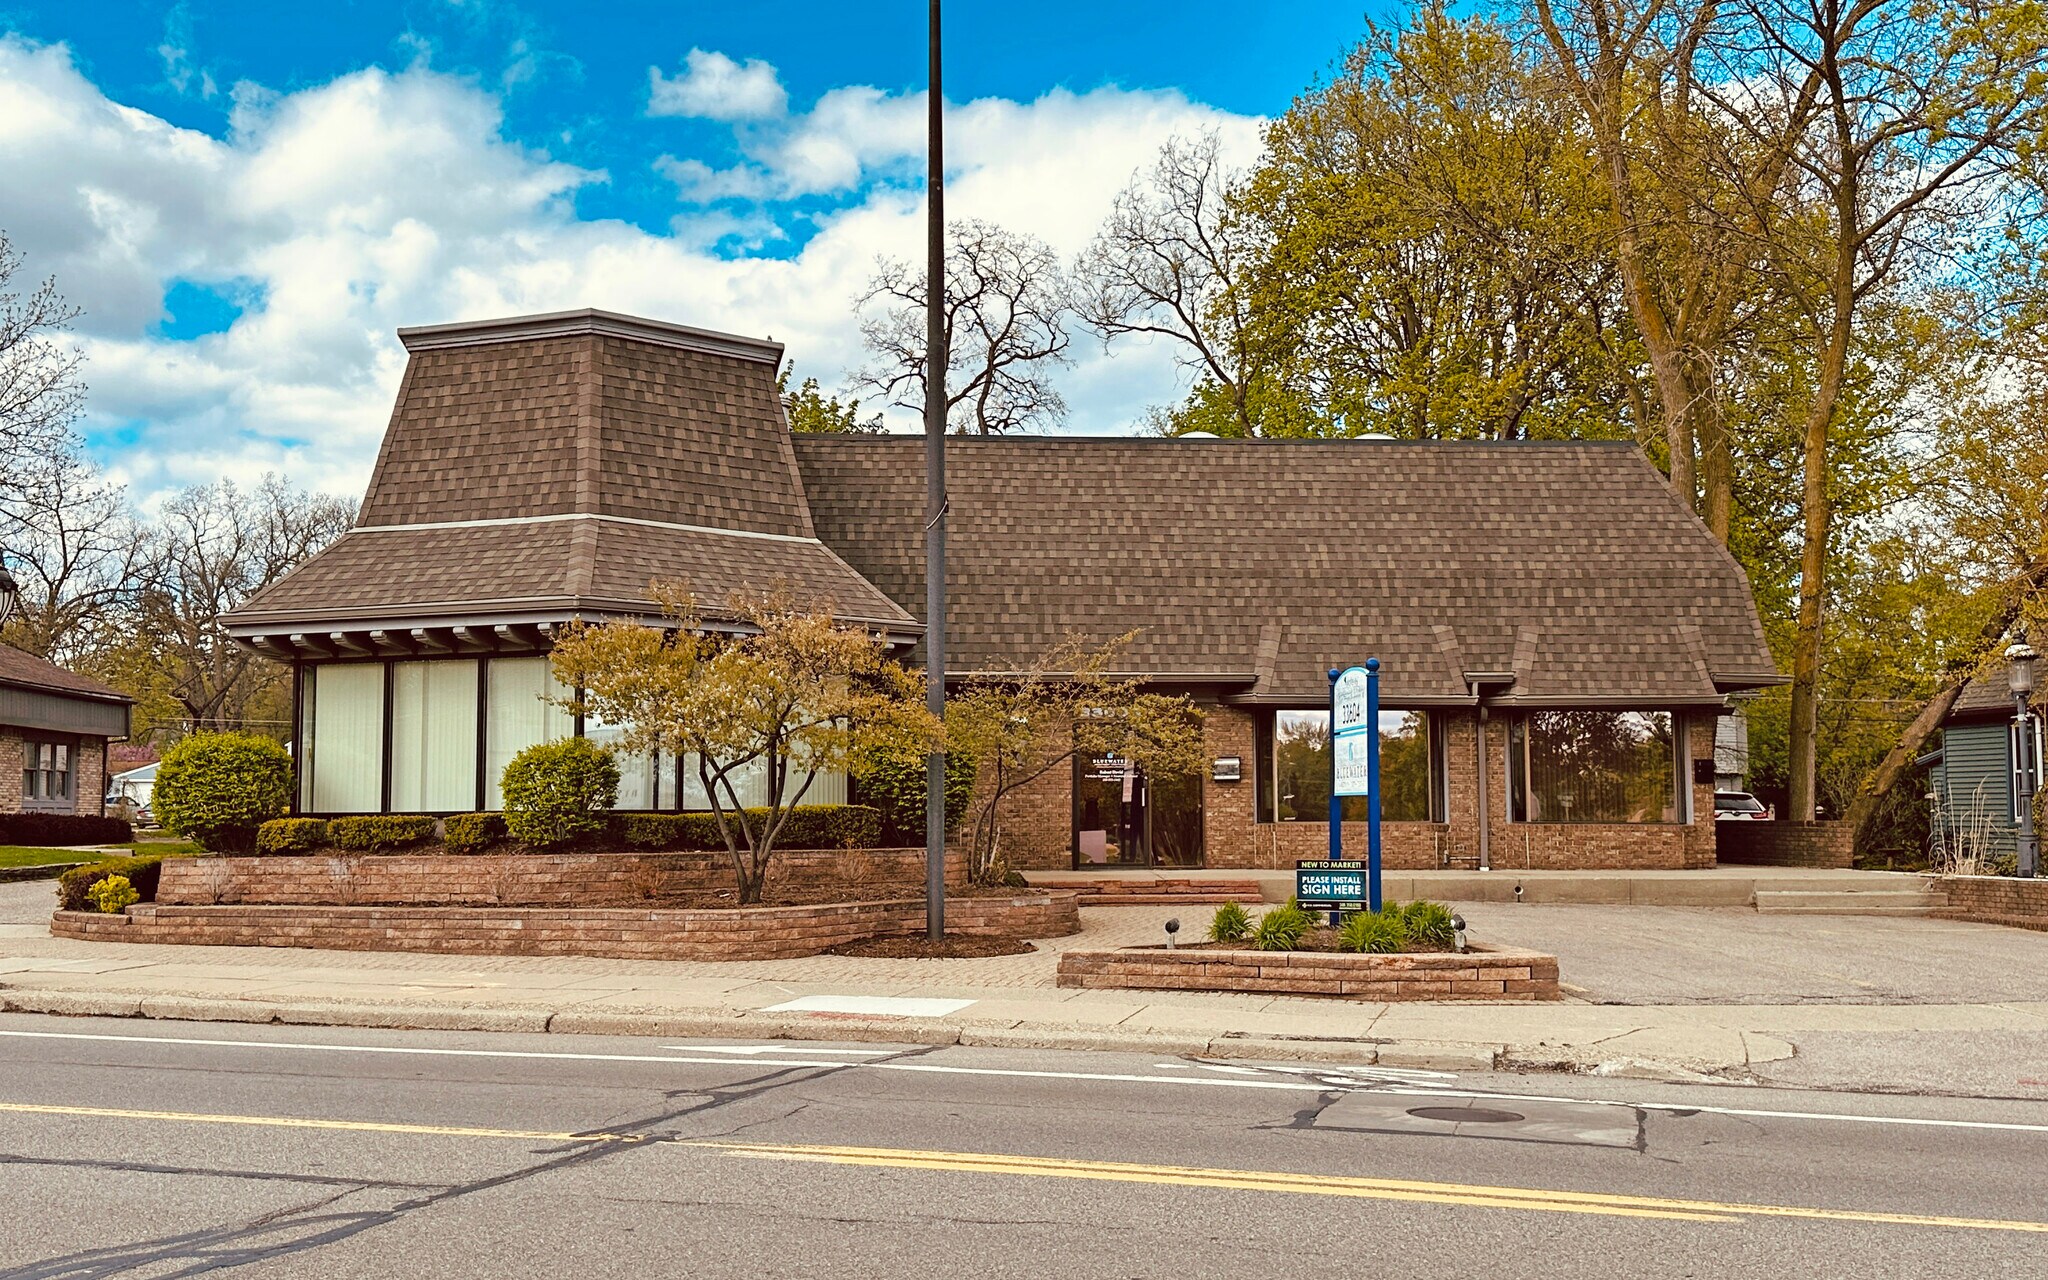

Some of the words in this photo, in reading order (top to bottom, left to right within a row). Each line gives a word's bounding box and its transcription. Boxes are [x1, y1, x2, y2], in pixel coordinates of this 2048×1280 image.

[1301, 861, 1318, 869] NEW
[1319, 861, 1329, 869] TO
[1330, 861, 1362, 869] MARKET!
[1301, 876, 1329, 884] PLEASE
[1331, 876, 1361, 884] INSTALL
[1301, 884, 1330, 895] SIGN
[1333, 884, 1361, 895] HERE
